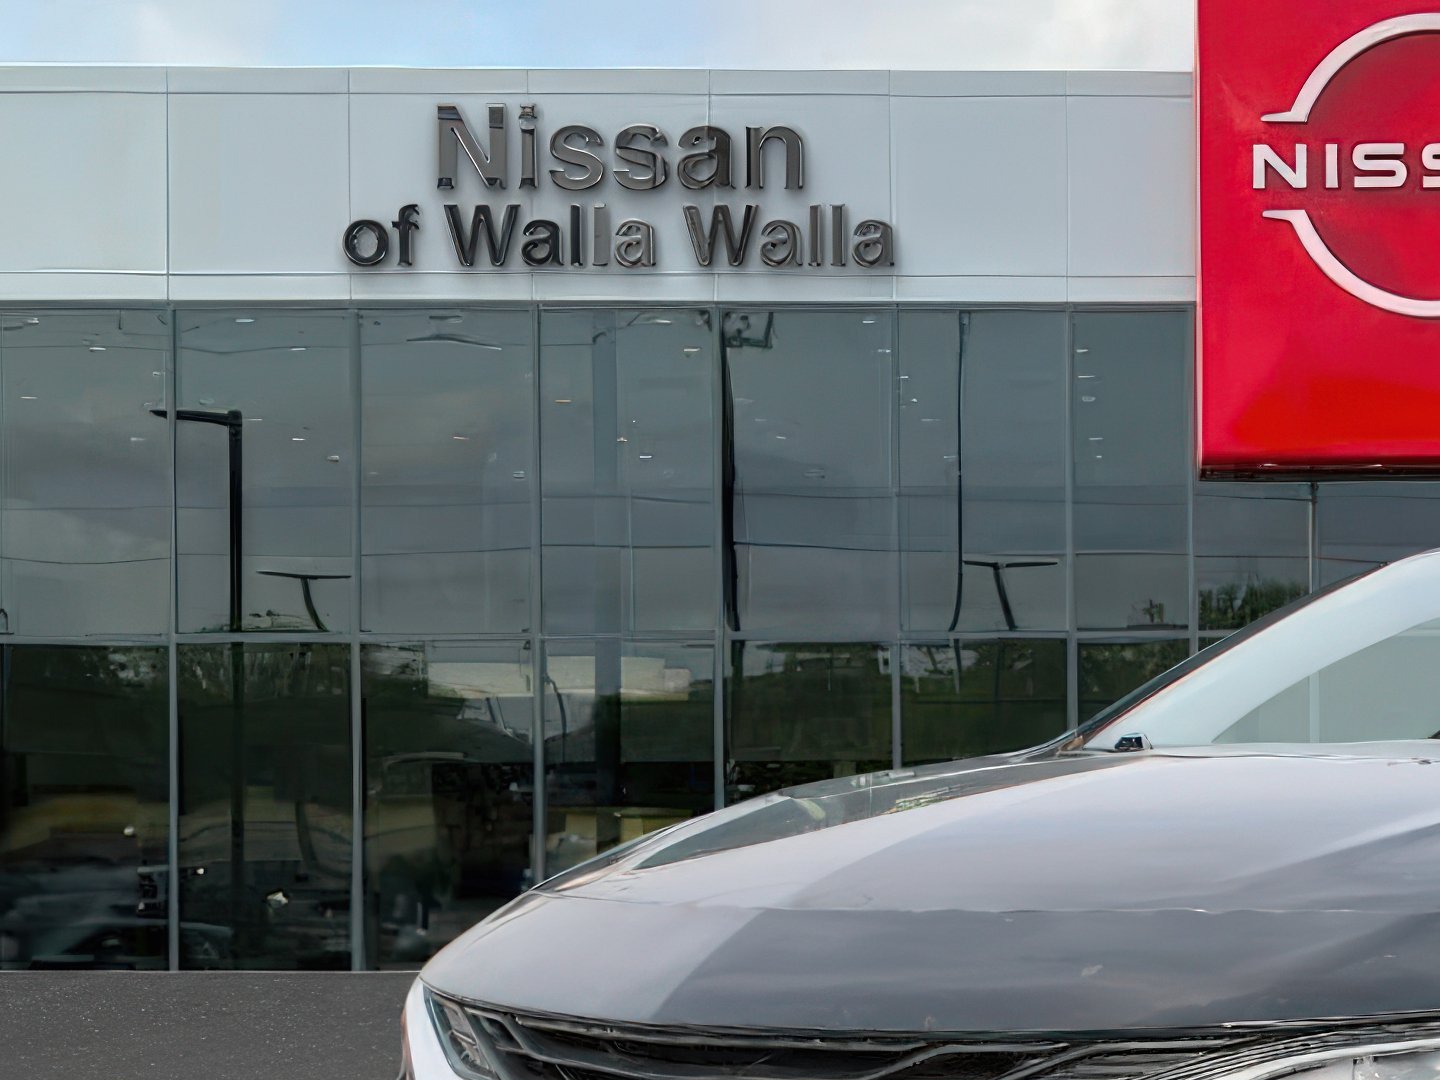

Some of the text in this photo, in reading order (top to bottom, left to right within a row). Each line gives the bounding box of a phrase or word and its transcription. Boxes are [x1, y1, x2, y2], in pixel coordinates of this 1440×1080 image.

[436, 102, 804, 191] Nissan
[342, 203, 895, 267] of Walla Walla
